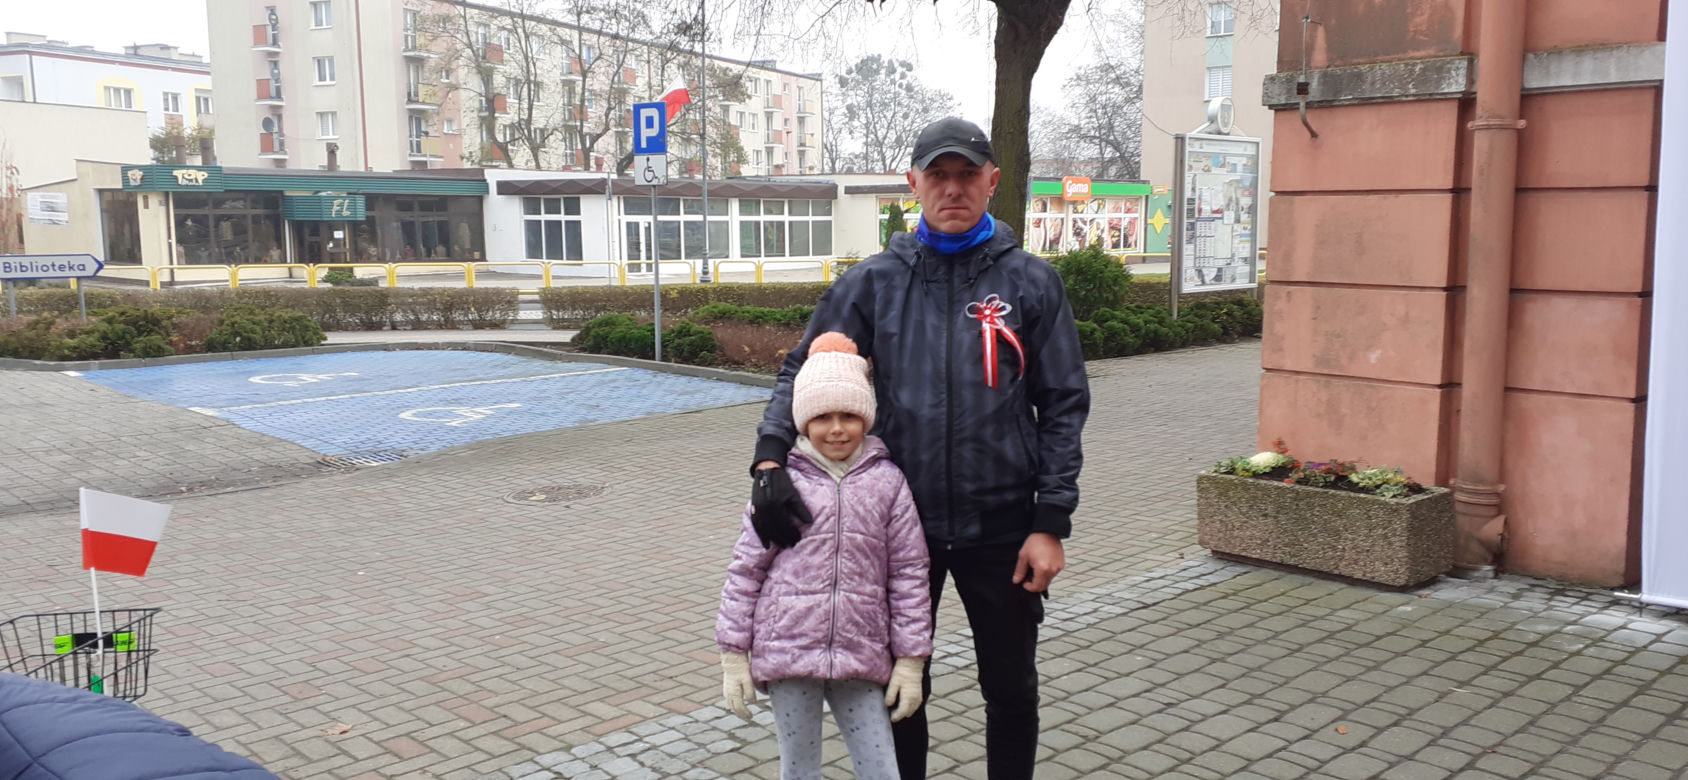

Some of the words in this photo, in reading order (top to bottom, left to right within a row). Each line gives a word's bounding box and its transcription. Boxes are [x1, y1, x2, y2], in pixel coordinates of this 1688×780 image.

[639, 107, 660, 149] P
[172, 169, 208, 186] TOP
[3, 260, 87, 273] Biblioteka
